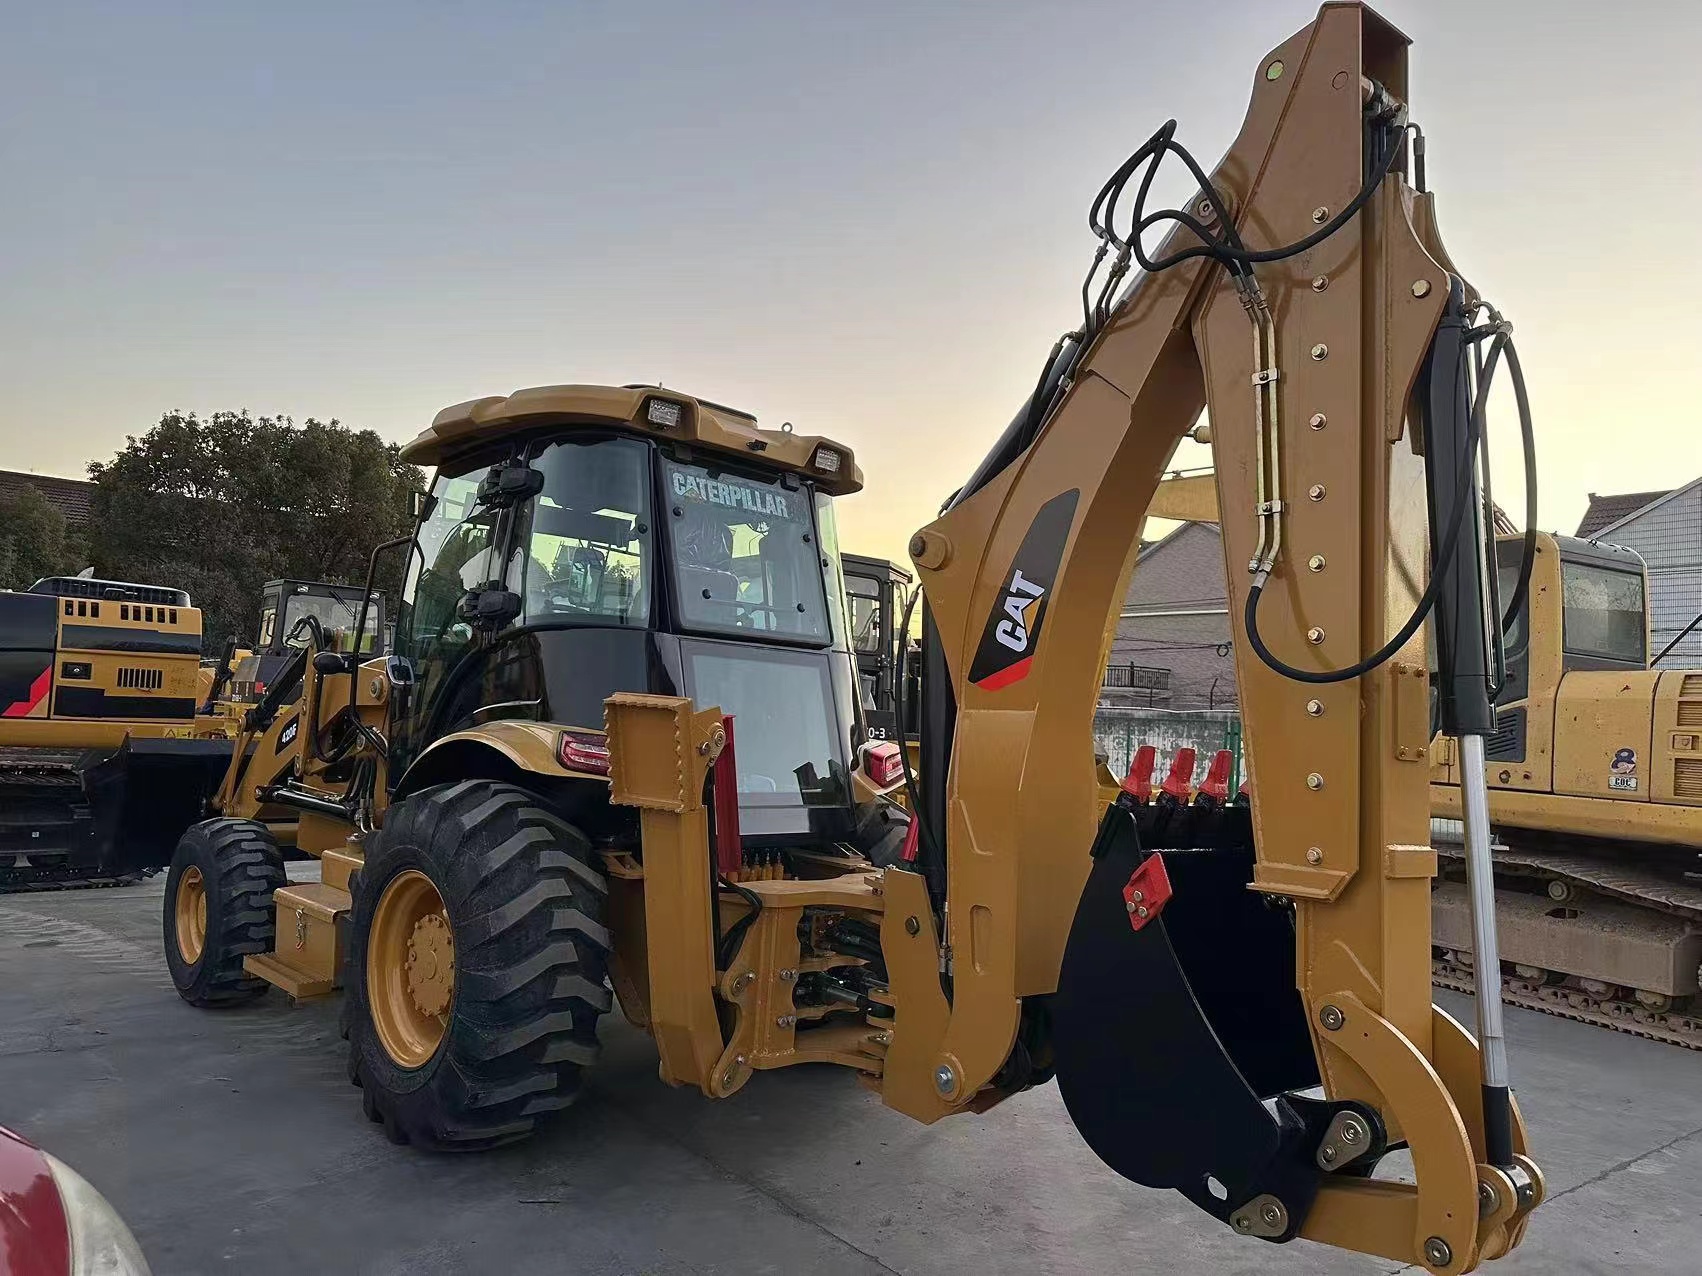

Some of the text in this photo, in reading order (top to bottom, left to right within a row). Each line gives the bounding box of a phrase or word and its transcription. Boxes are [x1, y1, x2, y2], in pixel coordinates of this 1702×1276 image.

[672, 472, 789, 518] CATERPILLAR
[995, 569, 1045, 652] CAT
[867, 727, 886, 739] 0-3
